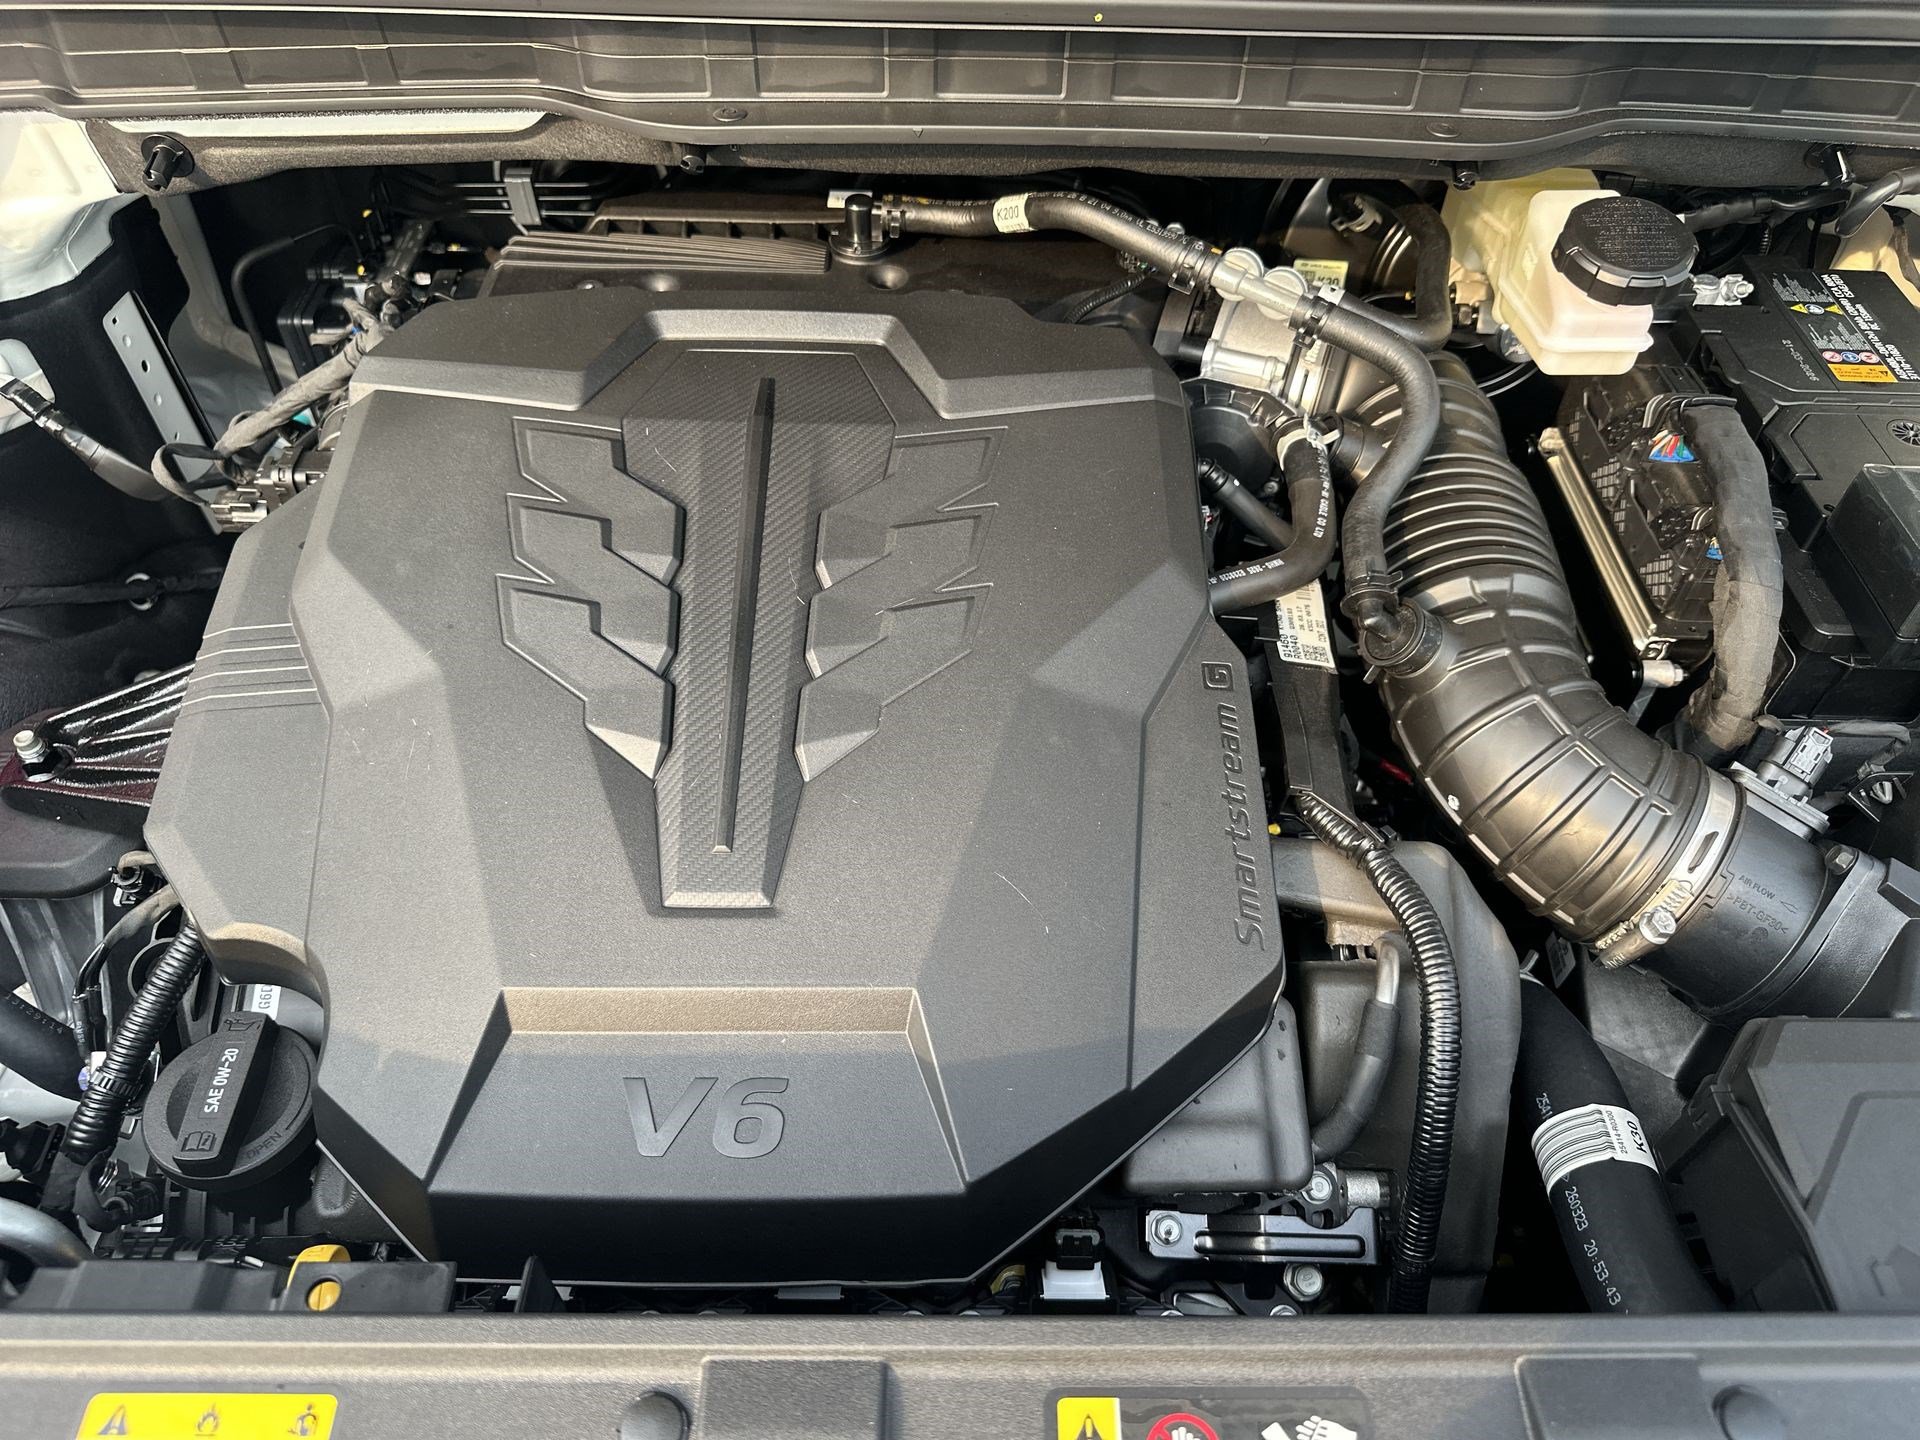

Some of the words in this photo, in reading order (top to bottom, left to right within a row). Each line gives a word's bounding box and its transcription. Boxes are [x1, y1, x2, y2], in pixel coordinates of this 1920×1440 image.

[996, 204, 1019, 223] K200
[1280, 633, 1293, 658] 91460
[1217, 702, 1265, 952] Smartstream
[1738, 874, 1752, 887] AIR
[1752, 882, 1776, 900] FLOW
[204, 1088, 224, 1113] SAE
[214, 1047, 240, 1086] 0W-20
[622, 1076, 790, 1160] V6
[246, 1131, 283, 1160] OPEN
[1627, 1119, 1647, 1154] K30
[1564, 1186, 1589, 1232] 260323
[1583, 1239, 1622, 1306] 20:53:43
